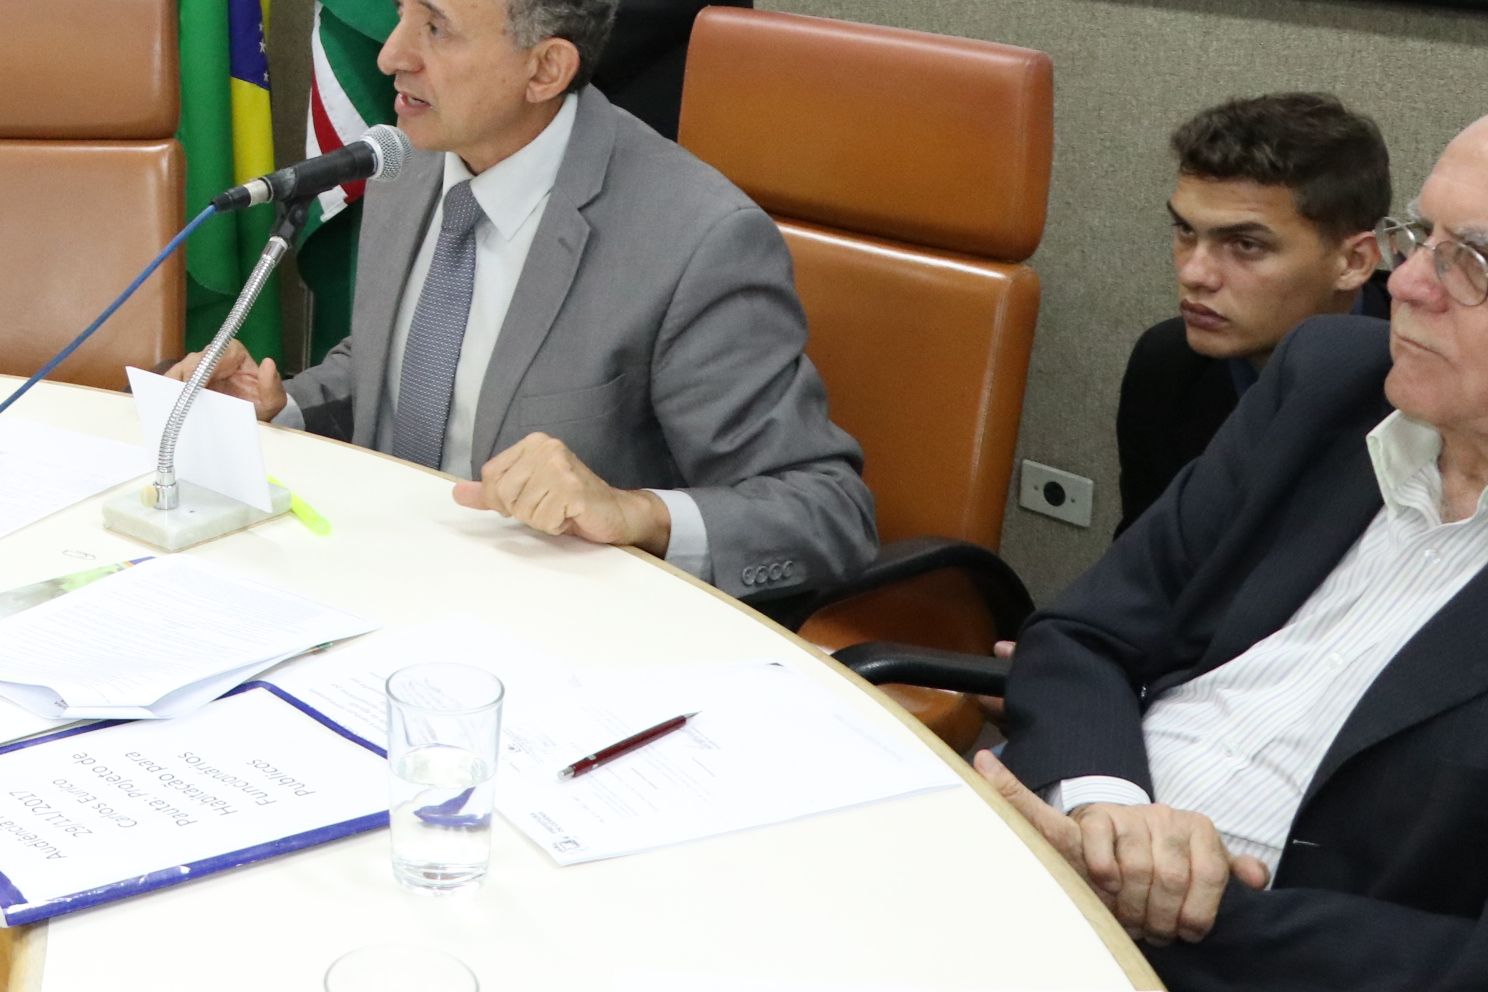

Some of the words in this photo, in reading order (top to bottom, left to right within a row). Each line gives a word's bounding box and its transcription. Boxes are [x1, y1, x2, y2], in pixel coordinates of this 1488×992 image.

[72, 752, 97, 765] de
[124, 751, 168, 773] para
[52, 778, 98, 804] Eurico
[91, 765, 149, 798] Projeto
[158, 773, 239, 816] Habitação
[177, 751, 278, 806] Funcionários
[8, 790, 94, 837] 29/11/2017
[91, 802, 138, 828] Carlos
[143, 796, 198, 827] Pauta:
[0, 820, 68, 860] Audiência
